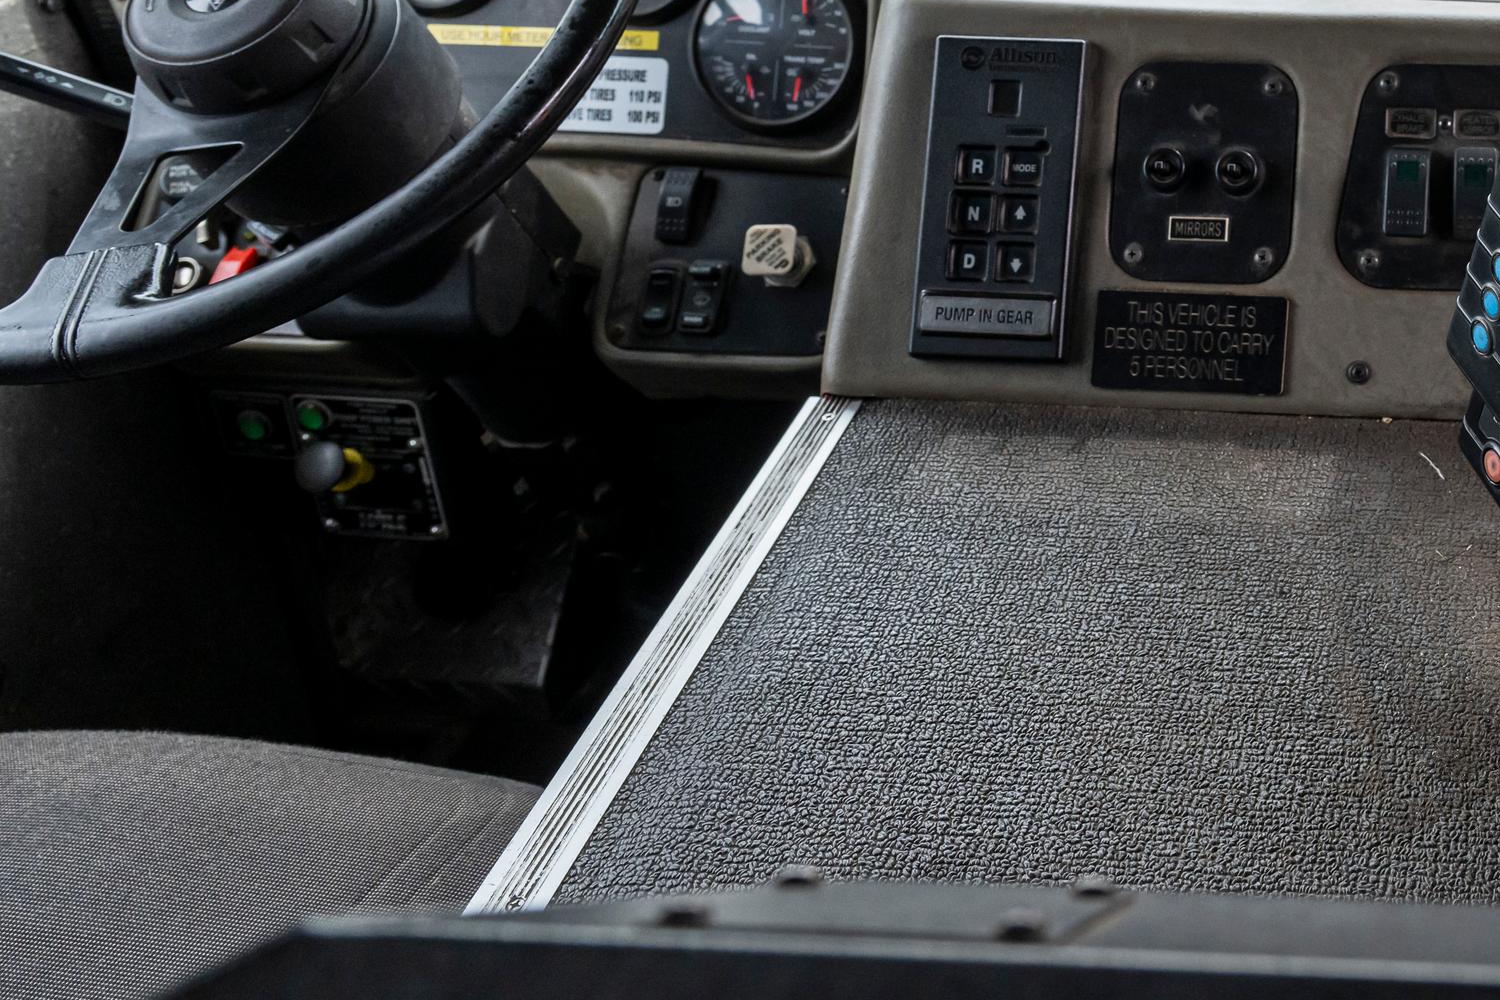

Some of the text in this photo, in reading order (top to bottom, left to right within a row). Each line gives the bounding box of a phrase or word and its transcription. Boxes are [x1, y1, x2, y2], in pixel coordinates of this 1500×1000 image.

[988, 47, 1057, 64] Allison
[590, 88, 662, 103] TIRES 110 PSI
[587, 109, 613, 122] TIRES
[645, 111, 660, 123] PSI
[971, 158, 984, 174] R
[1012, 163, 1037, 173] MODE
[967, 205, 980, 221] N
[1174, 220, 1222, 237] MIRRORS
[745, 227, 782, 259] PARKING
[755, 237, 784, 263] BRAKE
[962, 253, 976, 269] D
[934, 305, 1034, 325] PUMP IN GEAR
[1127, 300, 1257, 329] THIS VEHICLE IS
[1103, 326, 1276, 356] DESIGNED TO CARRY
[1128, 354, 1244, 382] 5 PERSONNEL
